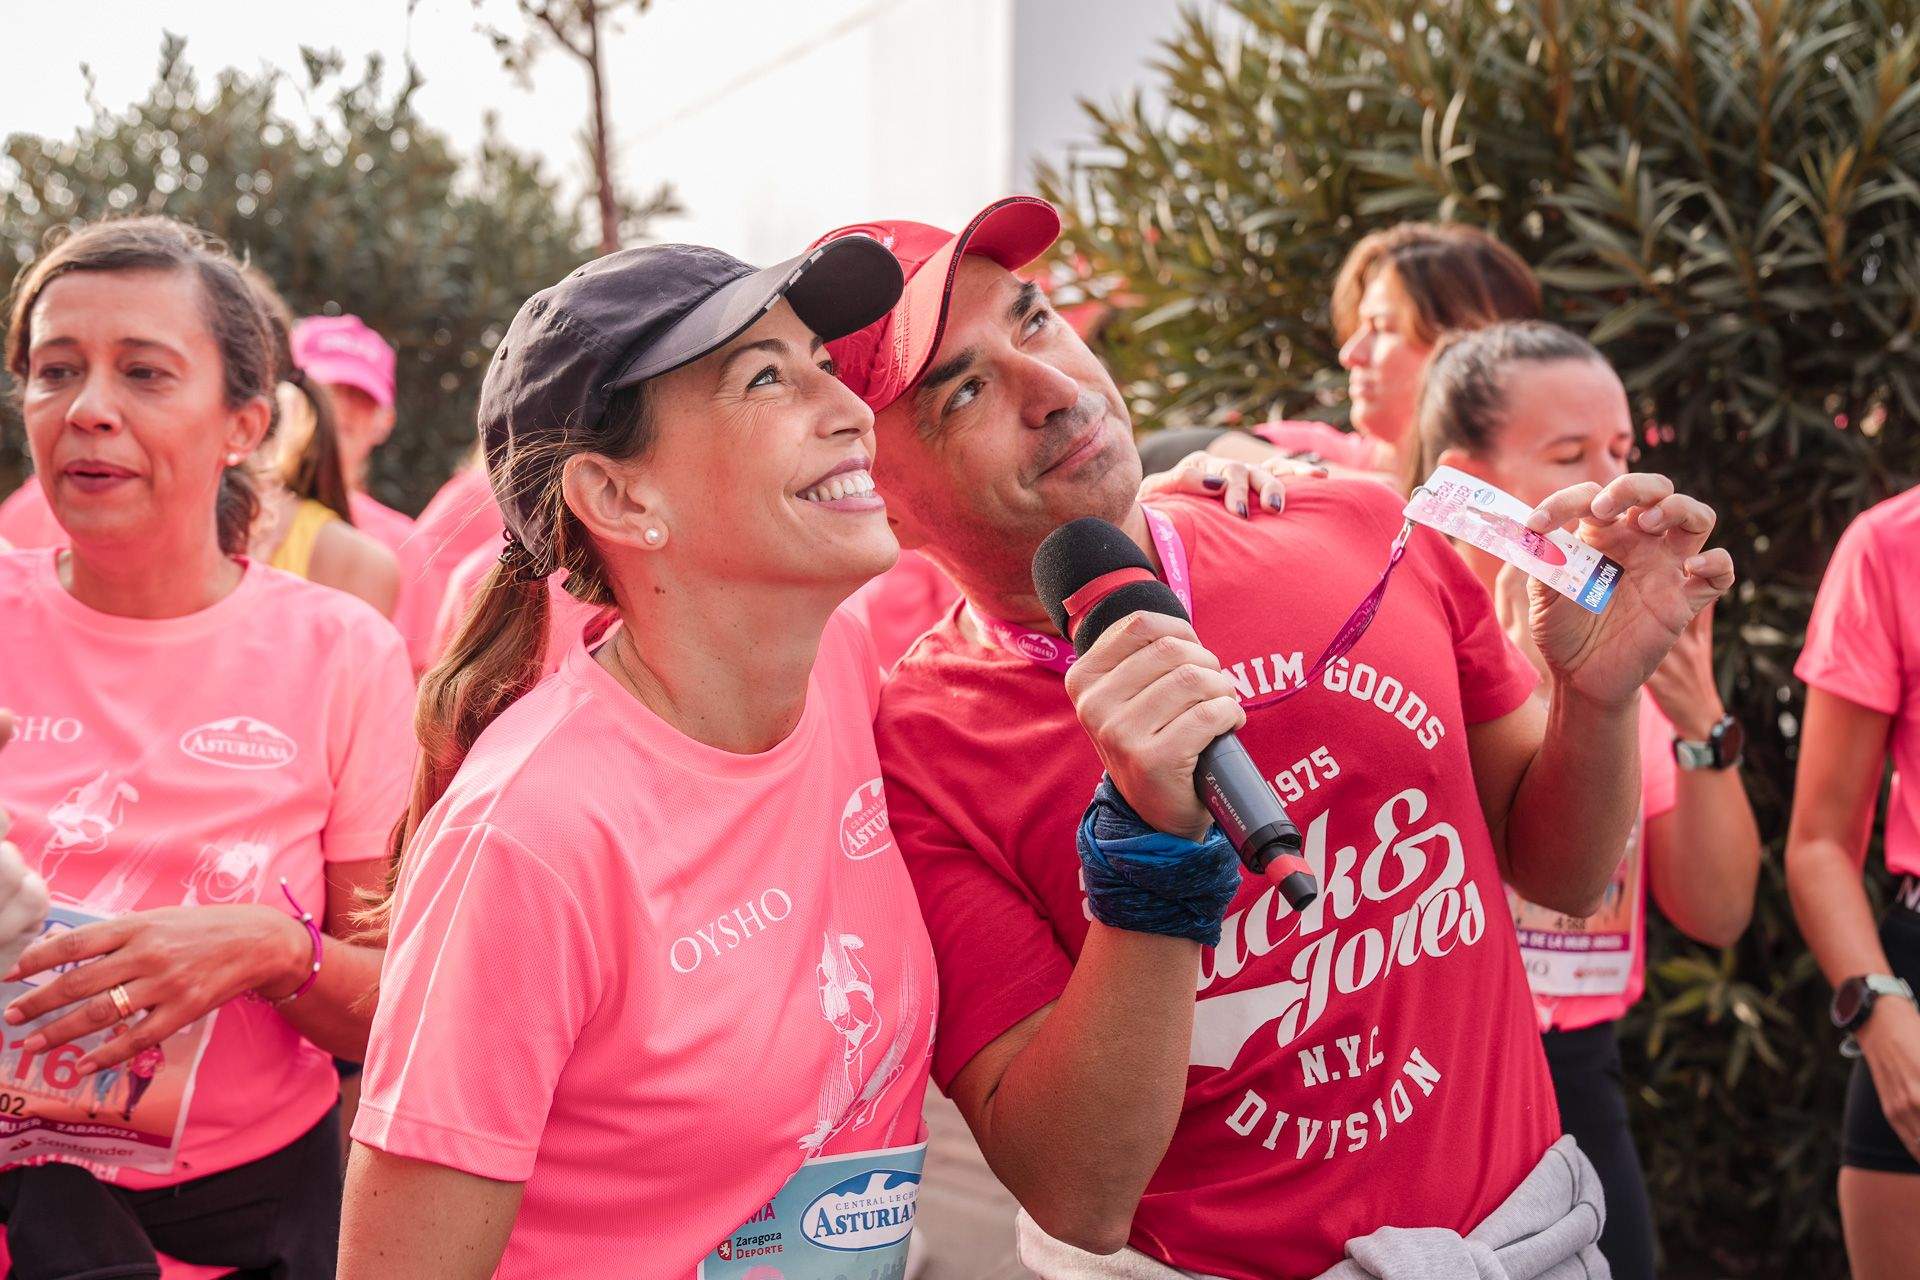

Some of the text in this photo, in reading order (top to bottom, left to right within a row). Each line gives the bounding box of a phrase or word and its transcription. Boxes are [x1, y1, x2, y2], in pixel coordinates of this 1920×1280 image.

[1323, 655, 1446, 750] GOODS
[188, 734, 290, 762] ASTURIANA
[1213, 783, 1247, 832] SENNHEISER
[1196, 788, 1466, 992] ack &
[669, 887, 792, 974] OYSHO
[1277, 880, 1486, 1049] Jones
[0, 1028, 87, 1090] 16
[1225, 1046, 1442, 1160] DIVISION
[36, 1137, 136, 1157] Santander
[56, 1123, 139, 1140] ZARAGOZA
[835, 1196, 885, 1211] CENTRAL
[736, 1232, 782, 1247] Zaragoza
[736, 1244, 784, 1260] DEPORTE
